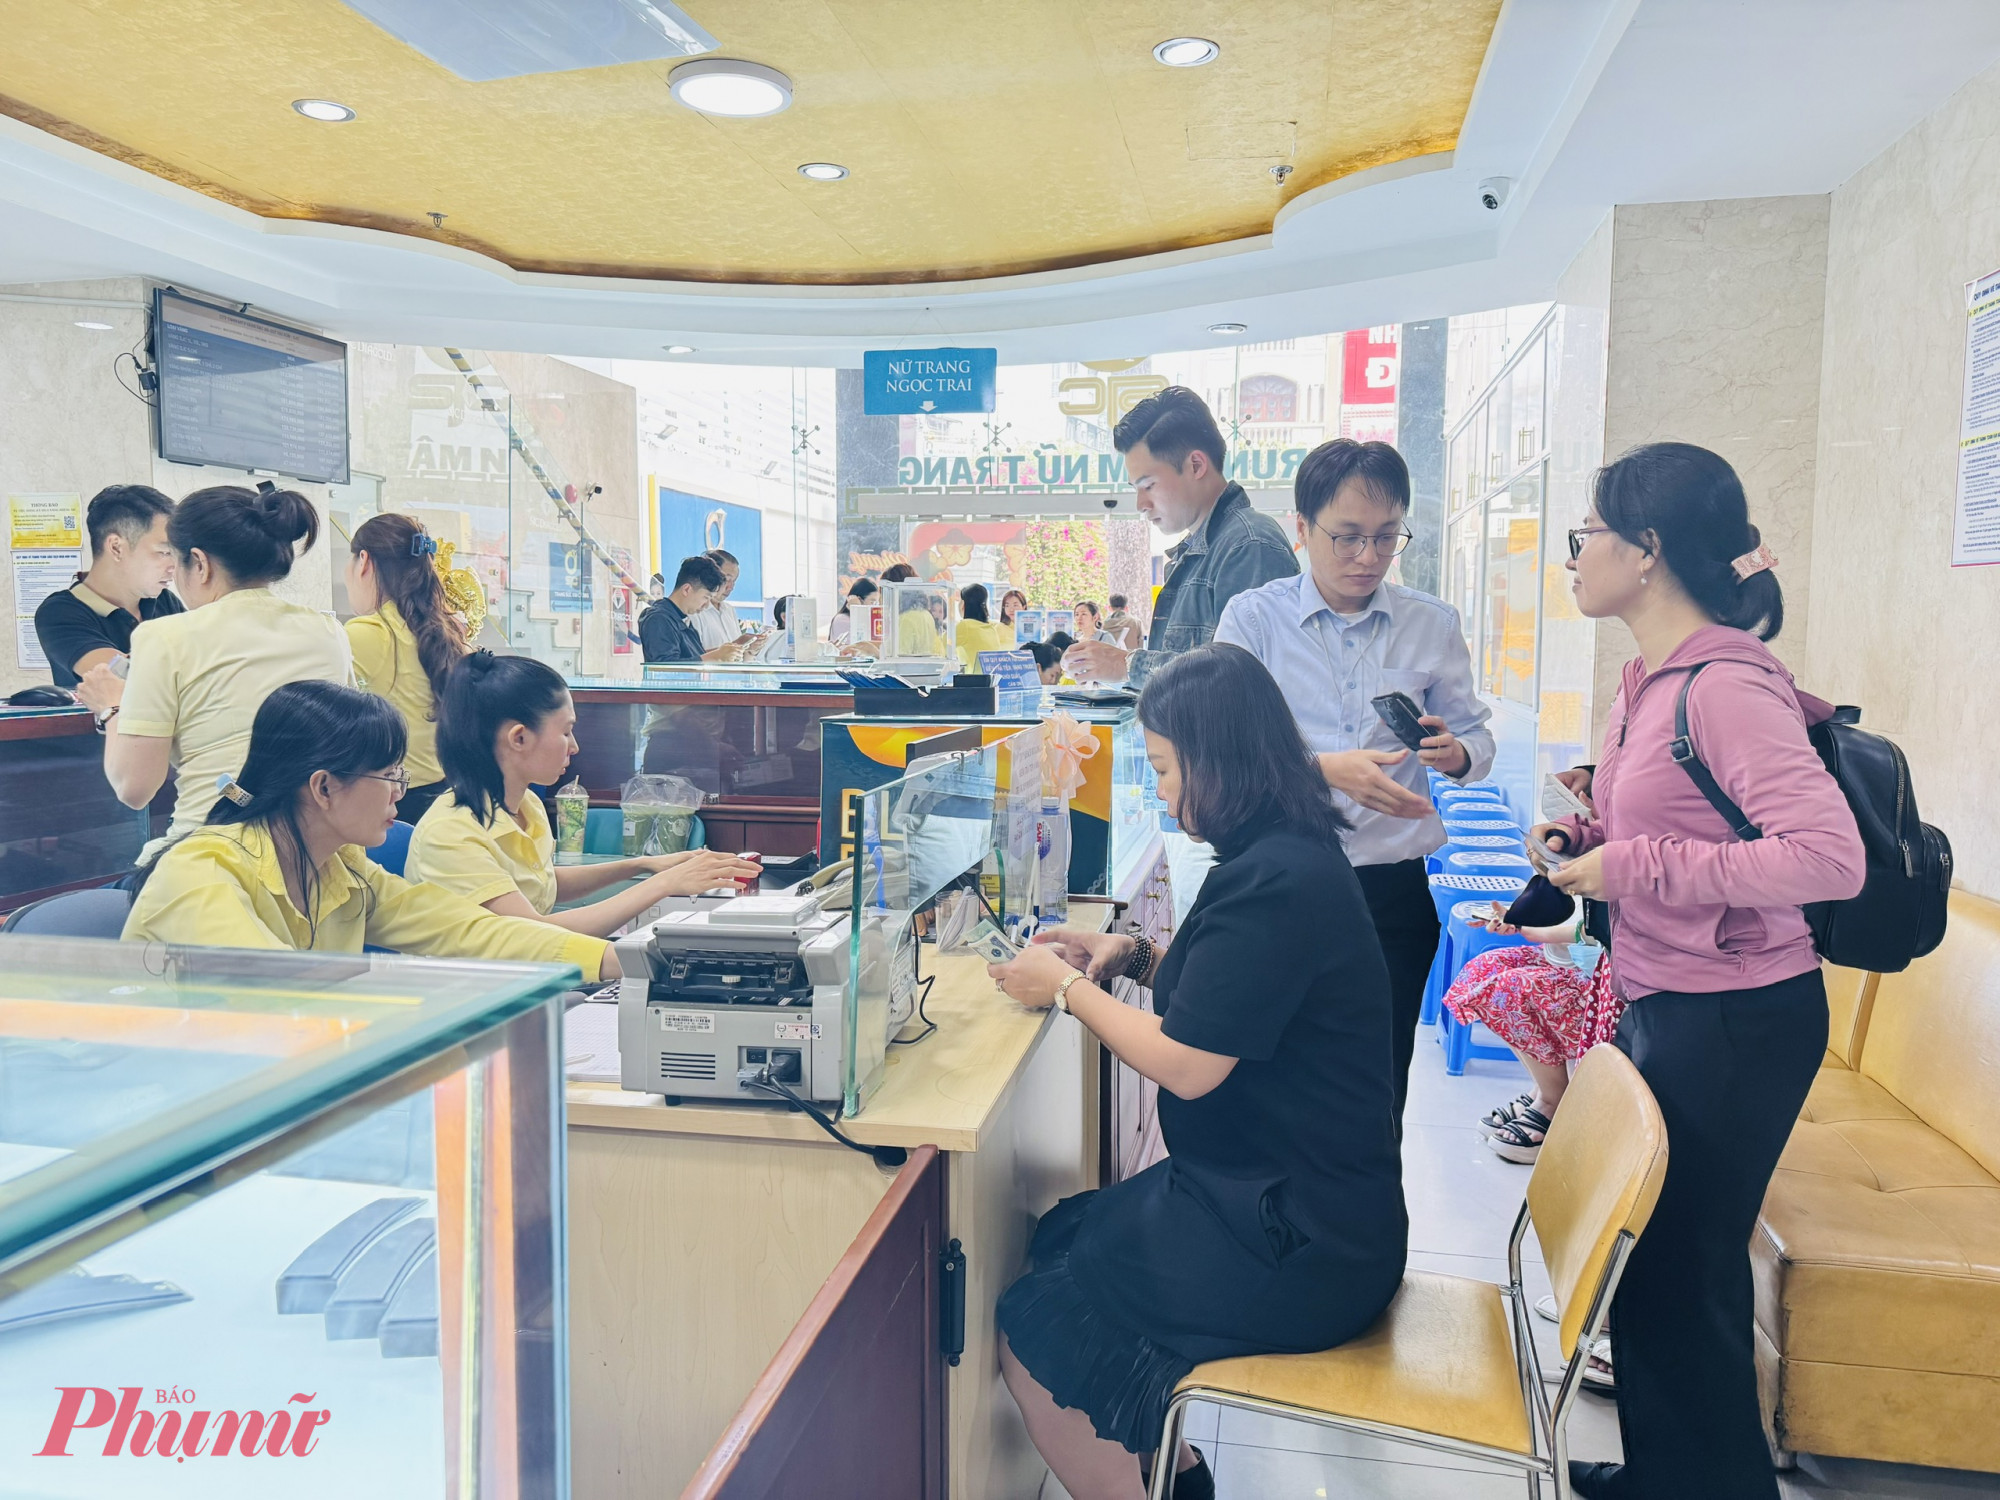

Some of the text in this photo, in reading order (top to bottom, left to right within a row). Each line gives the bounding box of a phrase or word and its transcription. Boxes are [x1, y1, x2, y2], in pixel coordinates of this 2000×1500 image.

[888, 359, 971, 375] NỮ TRANG
[886, 378, 972, 394] NGỌC TRAI
